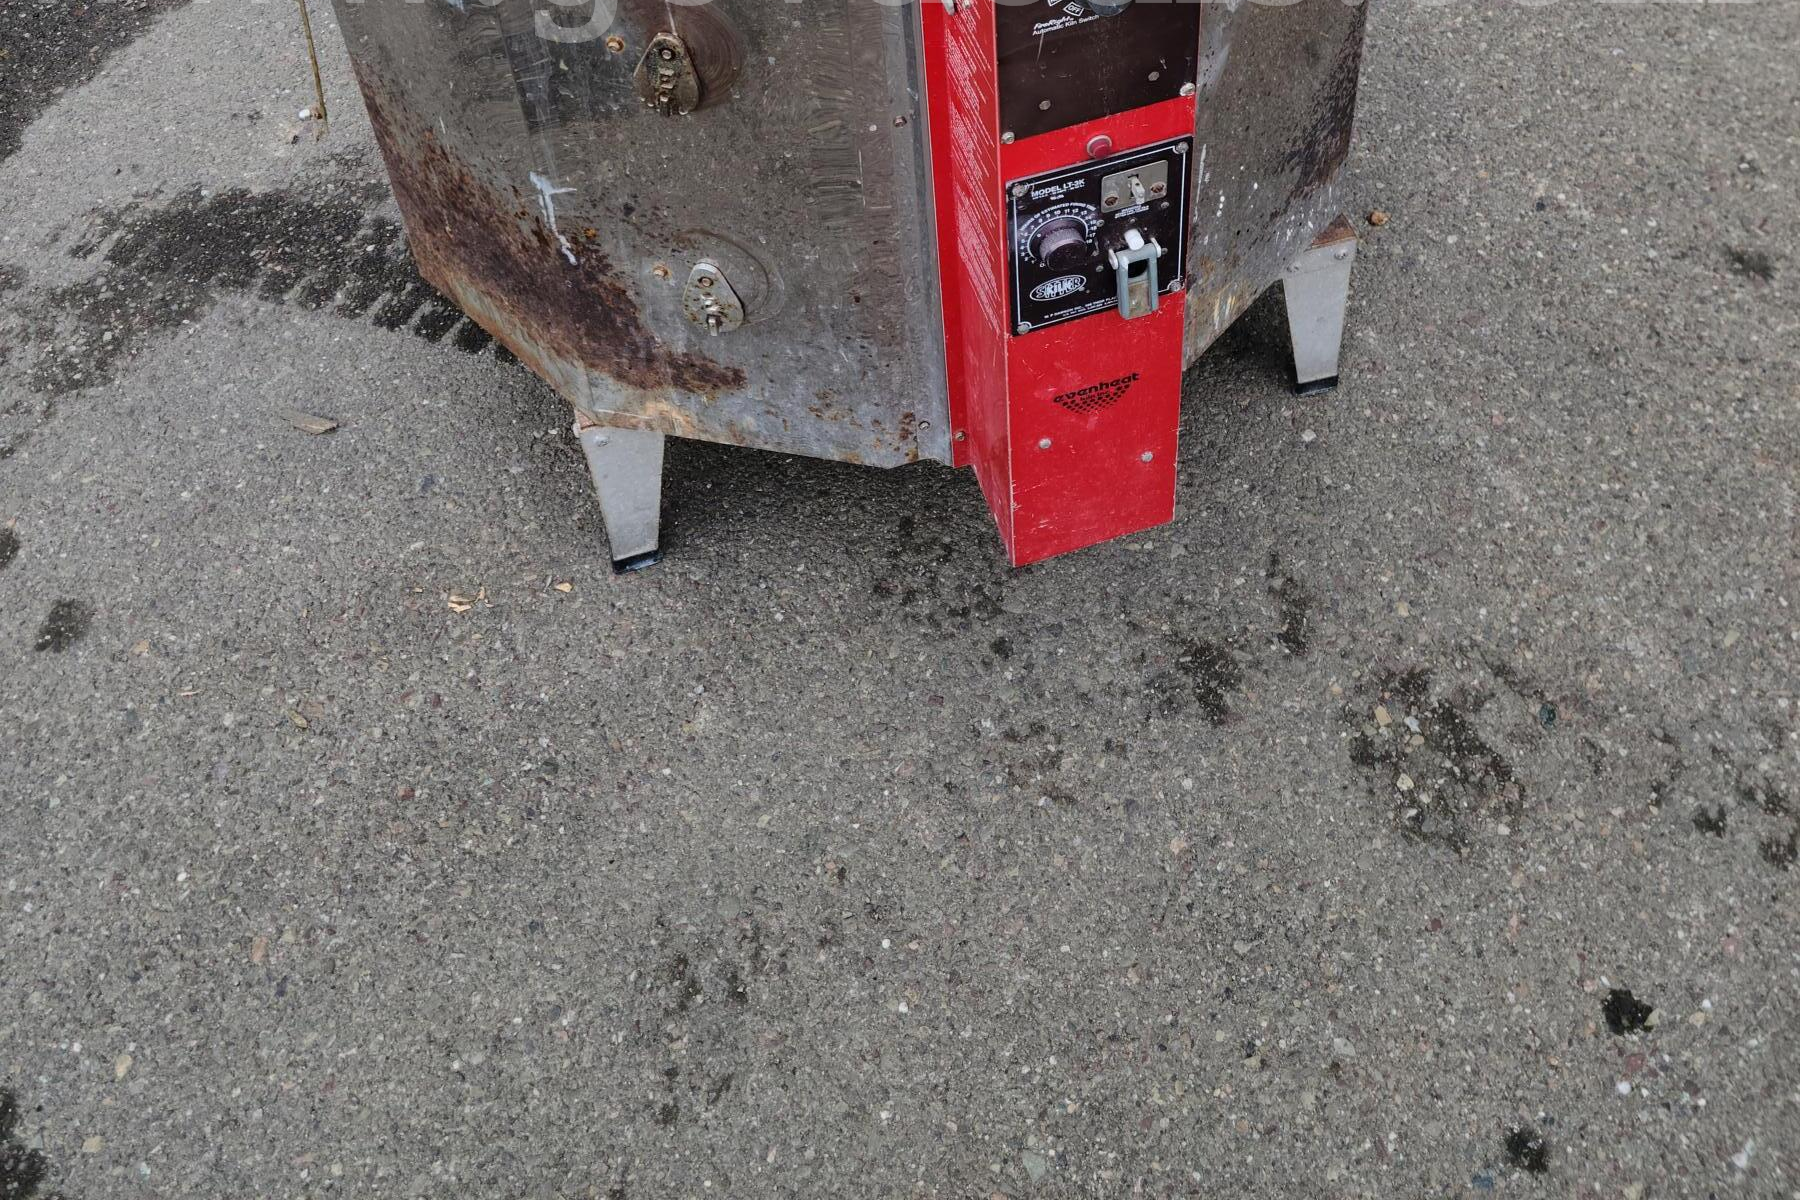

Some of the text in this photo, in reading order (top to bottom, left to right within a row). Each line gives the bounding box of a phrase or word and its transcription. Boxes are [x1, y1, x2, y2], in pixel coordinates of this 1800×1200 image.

[1067, 4, 1081, 13] OFF
[1032, 24, 1064, 36] Automatic
[1079, 14, 1100, 24] Switch
[1031, 185, 1061, 198] MODEL
